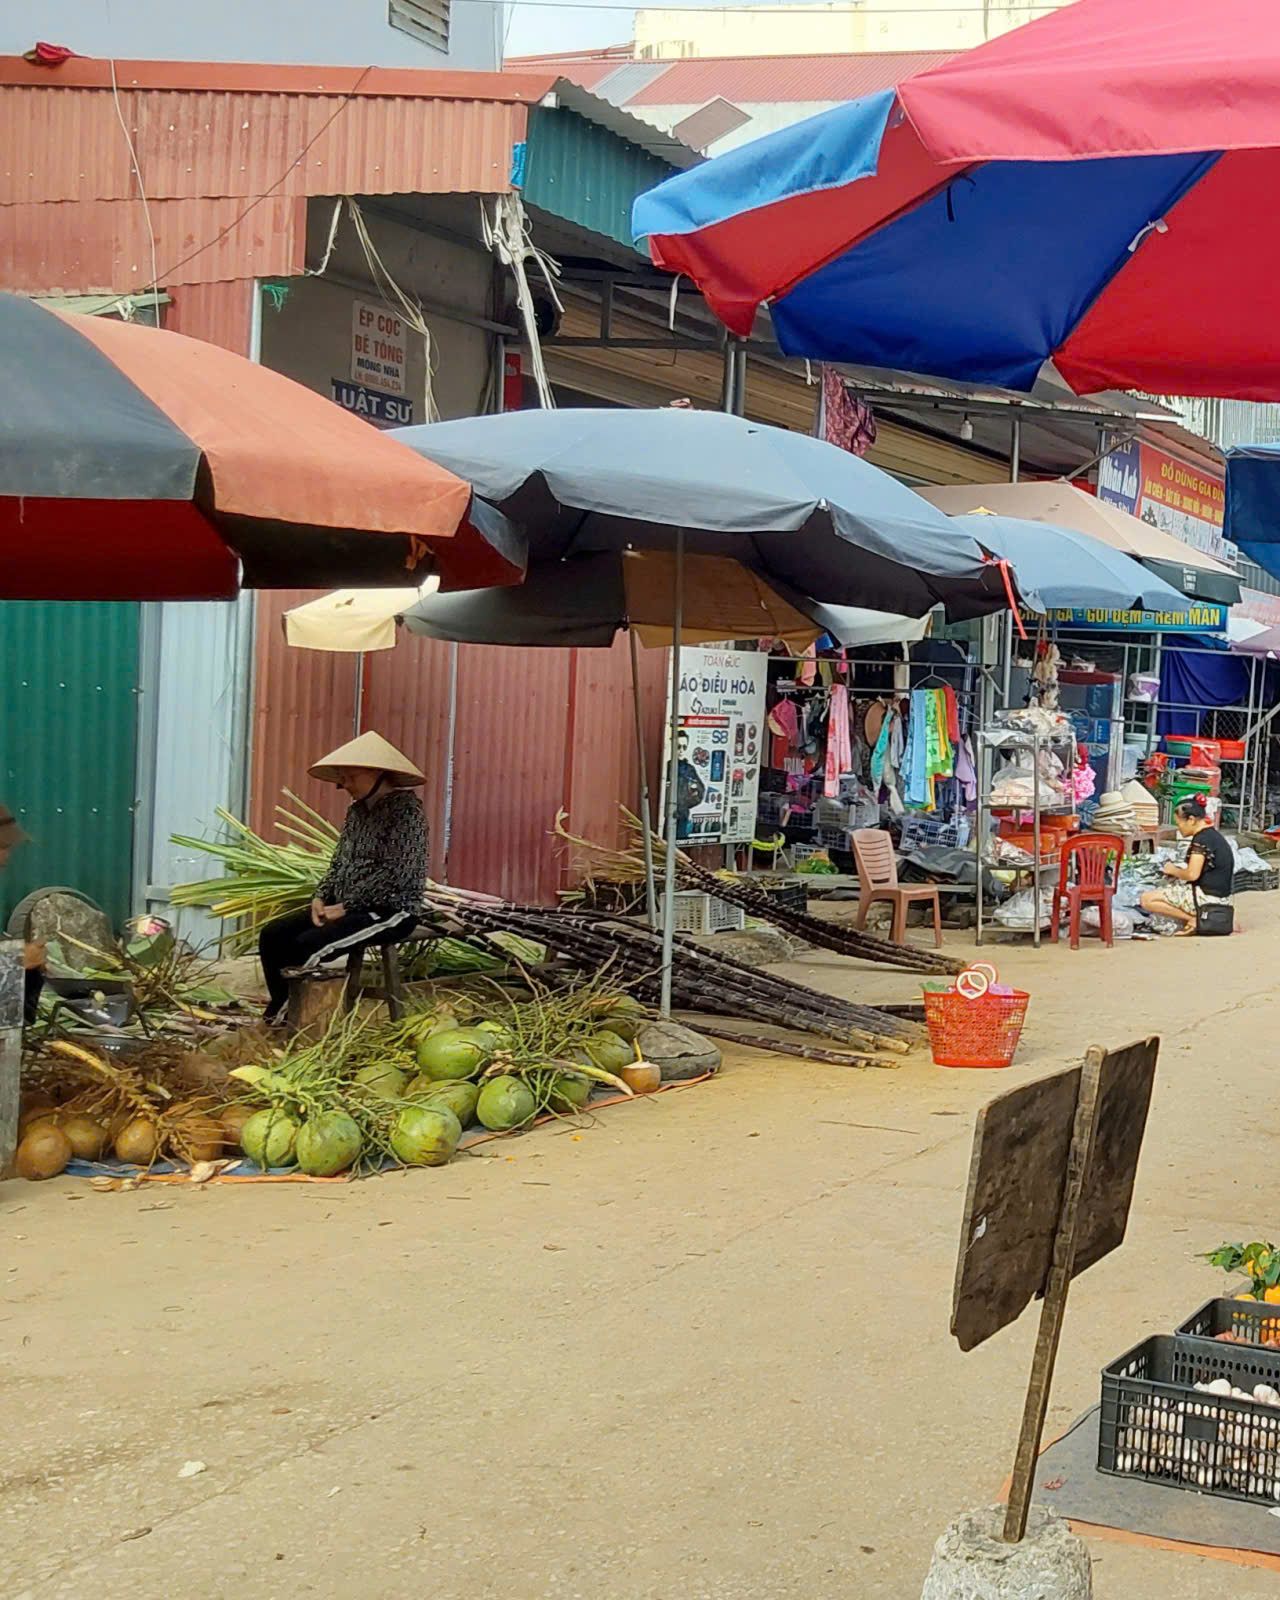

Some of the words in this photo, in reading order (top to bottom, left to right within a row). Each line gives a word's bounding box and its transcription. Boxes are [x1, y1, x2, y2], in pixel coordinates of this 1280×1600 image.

[377, 314, 401, 338] CỌC
[331, 386, 381, 415] LUẬT
[385, 401, 413, 423] SƯ
